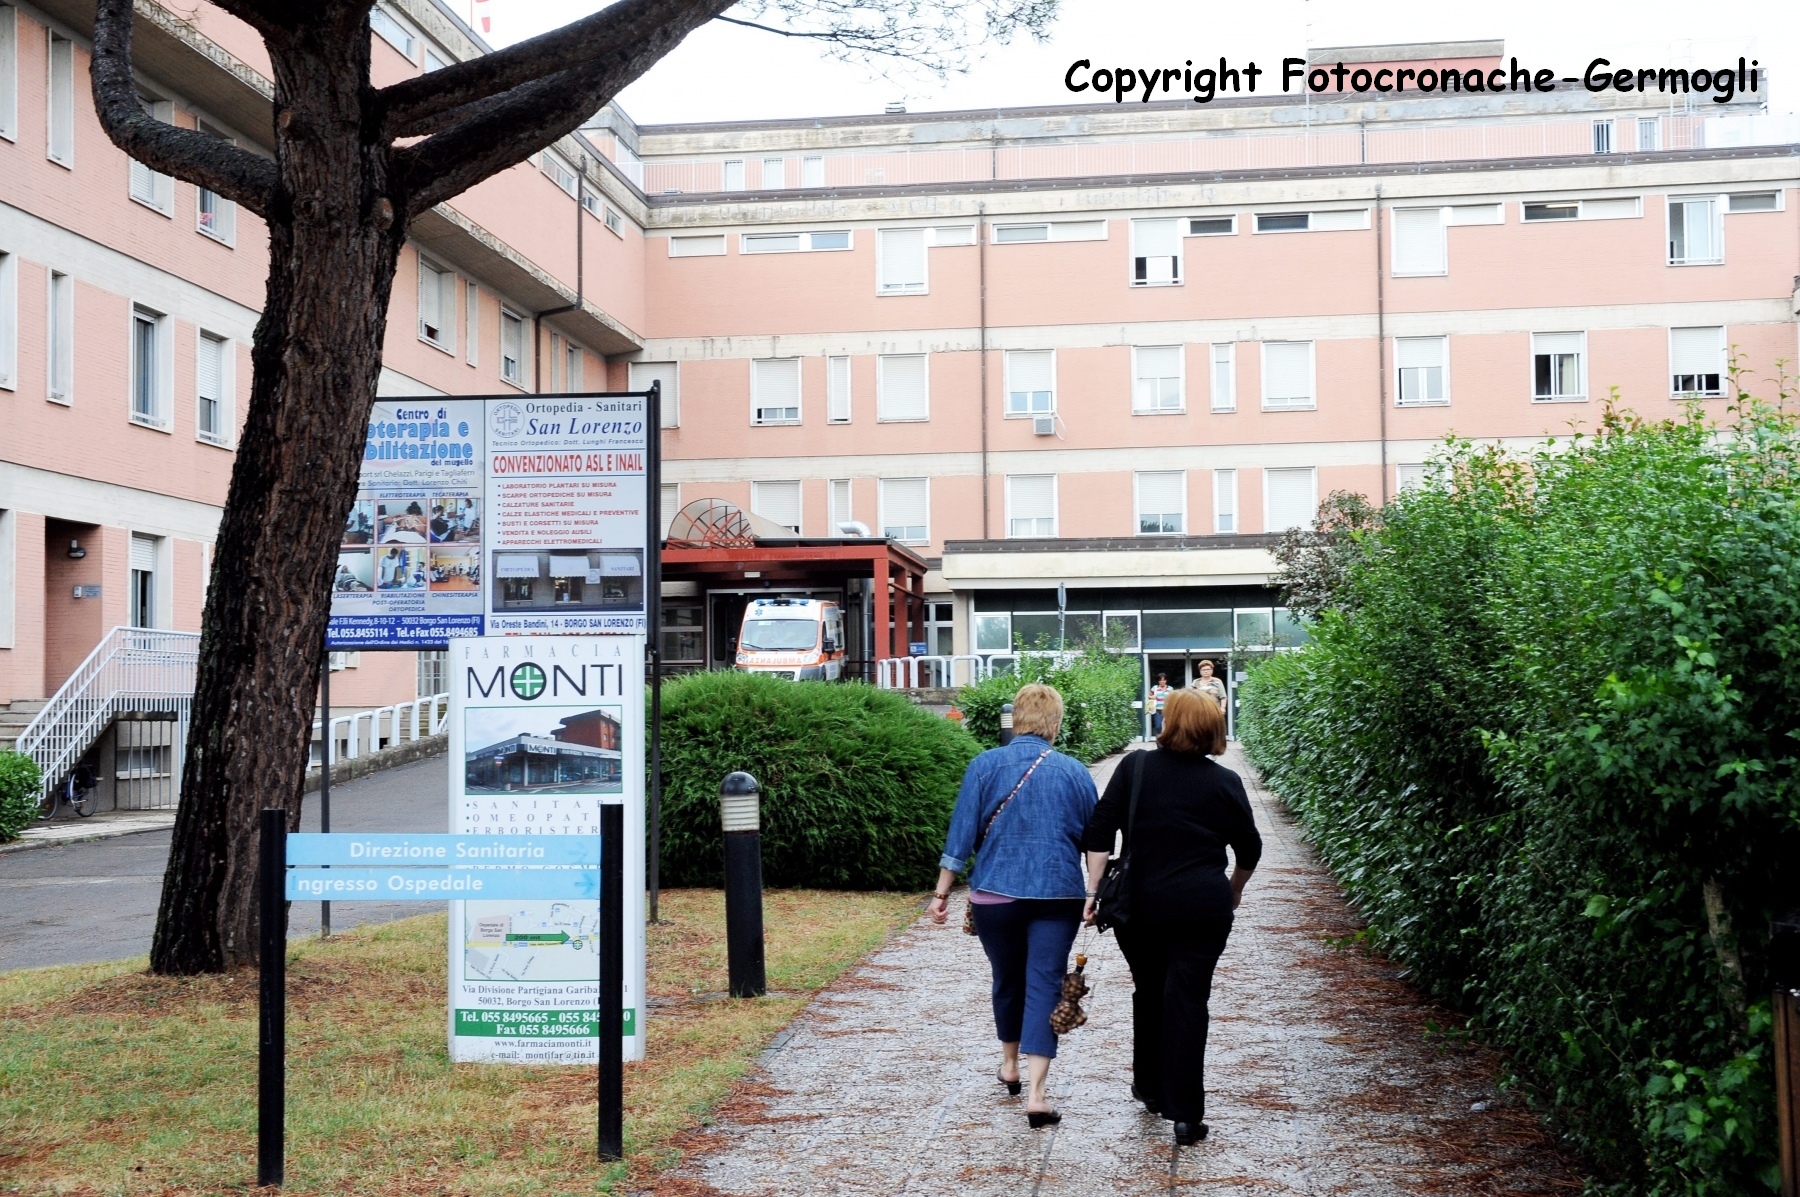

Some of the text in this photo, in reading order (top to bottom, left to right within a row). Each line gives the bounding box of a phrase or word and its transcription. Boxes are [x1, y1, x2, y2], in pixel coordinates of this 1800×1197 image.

[396, 407, 447, 420] Centro di
[526, 402, 583, 415] Ortopedia
[596, 401, 642, 412] Sanitari
[367, 419, 469, 441] oterapia e
[526, 417, 642, 436] San Lorenzo
[365, 440, 473, 460] bilitazione
[444, 459, 474, 467] mugello
[494, 454, 643, 473] CONVENZIONATO ASL E INAIL
[414, 470, 434, 478] Parigi
[420, 617, 436, 626] Borgo
[490, 620, 499, 629] Via
[502, 620, 521, 628] Oreste
[524, 619, 548, 630] Bandini,
[551, 619, 559, 628] 14
[565, 619, 587, 628] BORGO
[589, 619, 602, 628] SAN
[604, 619, 634, 628] LORENZO
[636, 619, 646, 629] (FI)
[416, 627, 429, 637] Fax
[465, 644, 622, 660] FARMACIA
[467, 662, 623, 701] MONTI
[472, 813, 589, 822] OMEOPAT
[472, 826, 598, 834] ERBORISTER
[350, 842, 545, 858] Direzione Sanitaria
[388, 875, 484, 894] Ospedale
[462, 985, 476, 994] Via
[478, 985, 515, 994] Divisione
[518, 985, 563, 996] Partigiana
[566, 985, 600, 994] Garibal
[478, 997, 504, 1006] 50032,
[506, 997, 531, 1007] Borgo
[534, 997, 550, 1006] San
[553, 997, 590, 1006] Lorenzo
[460, 1011, 479, 1022] Tel.
[481, 1012, 500, 1022] 055
[502, 1012, 549, 1023] 8495665
[558, 1012, 579, 1023] 055
[496, 1024, 590, 1035] Fax 055 8495666
[494, 1040, 591, 1048] www.farmaciamonti.it
[491, 1051, 520, 1059] e-mail:
